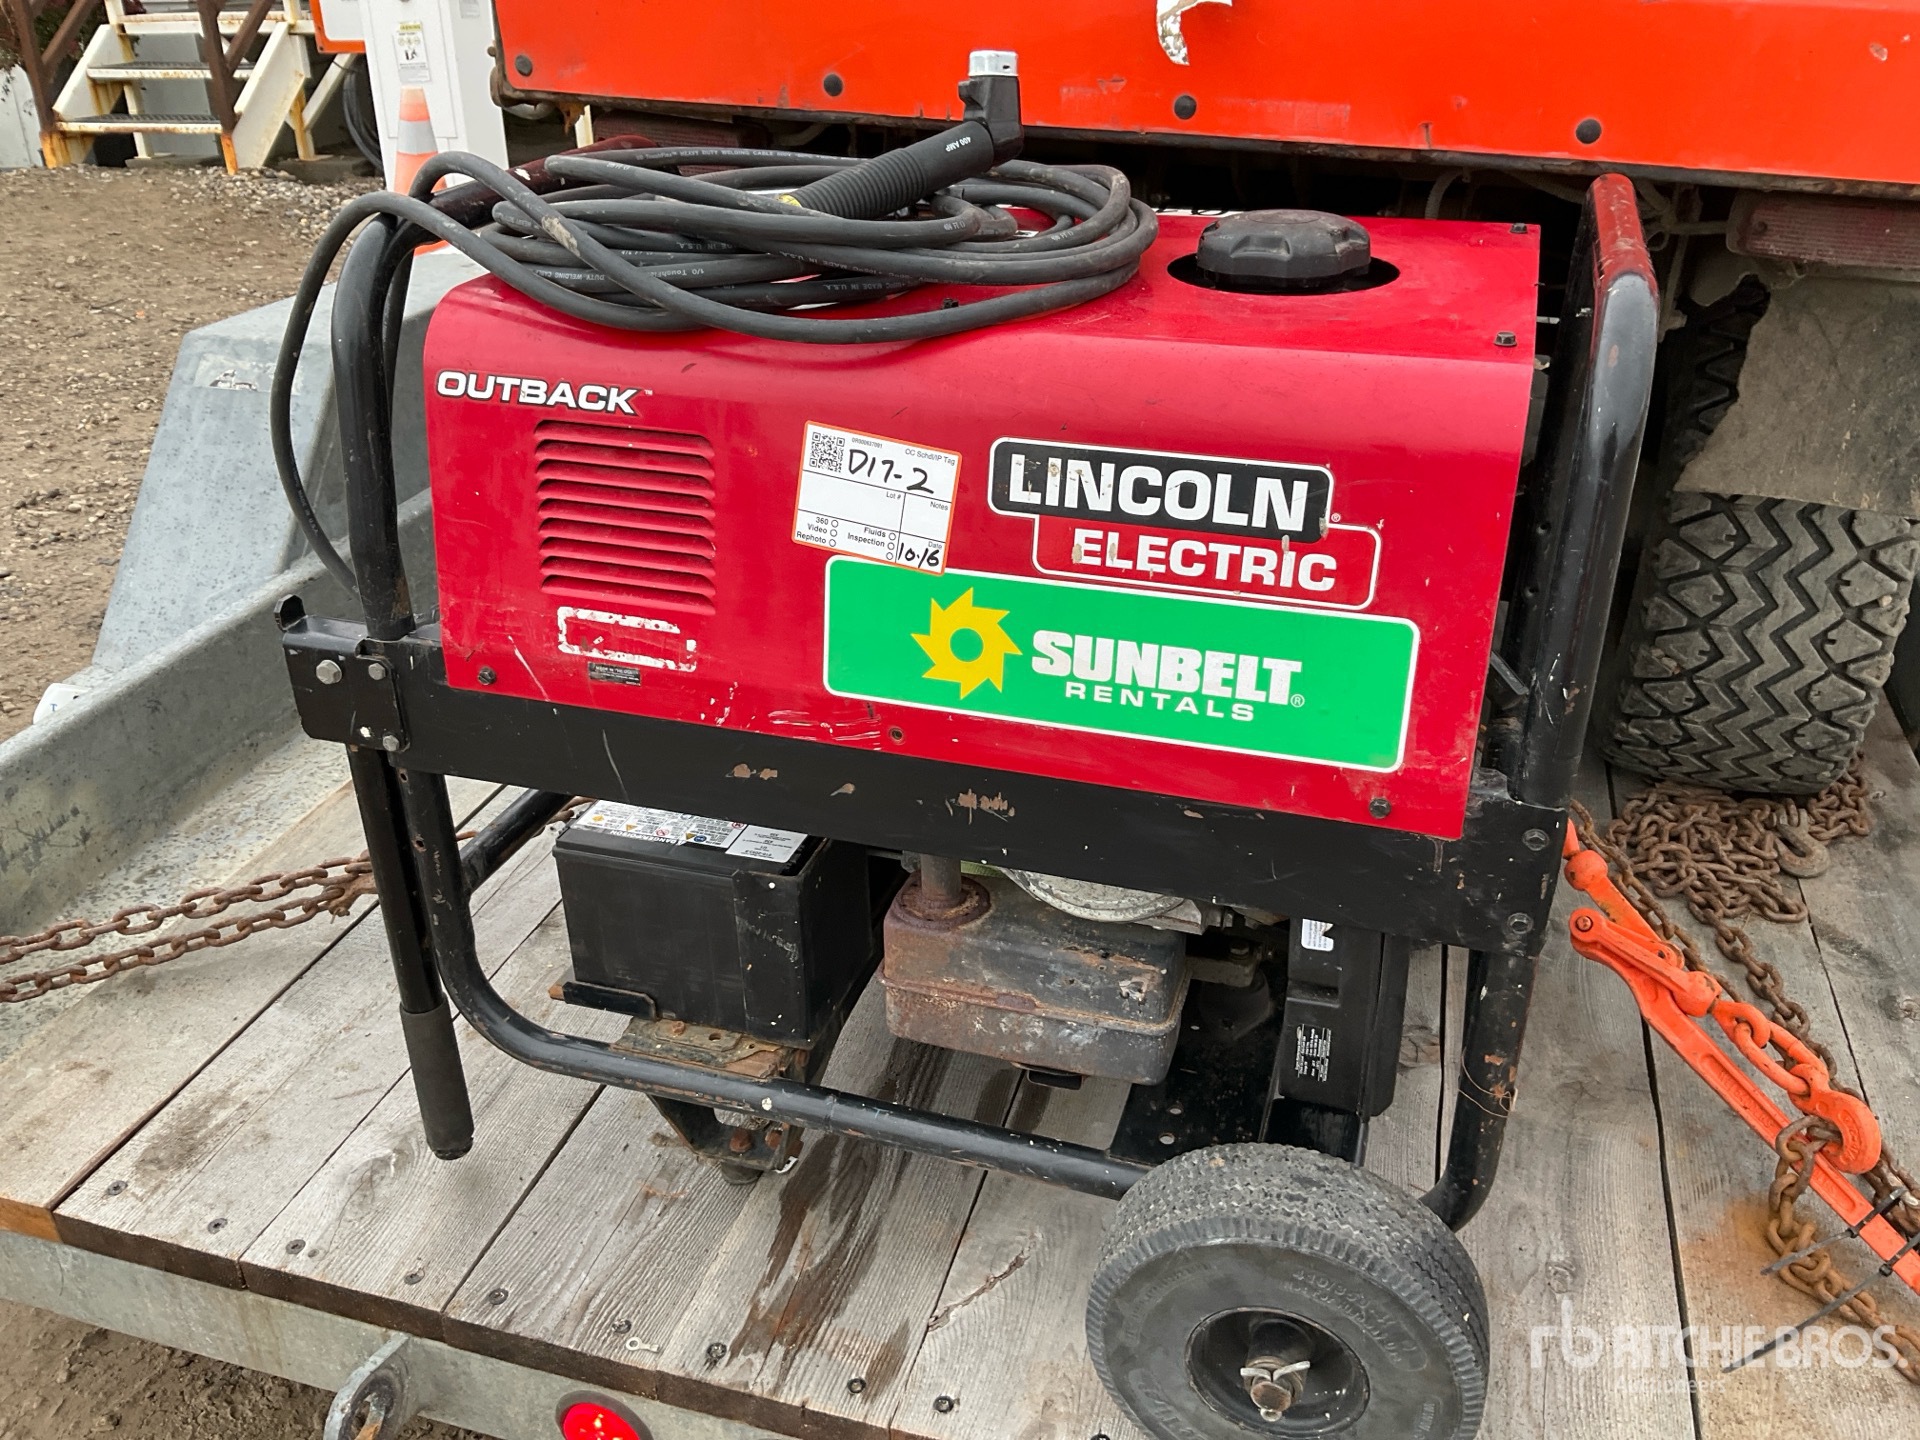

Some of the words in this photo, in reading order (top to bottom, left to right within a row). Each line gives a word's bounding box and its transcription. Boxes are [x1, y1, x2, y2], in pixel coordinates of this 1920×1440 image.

[945, 140, 960, 152] AMP
[960, 136, 971, 146] 400
[554, 272, 583, 280] WELDING
[648, 268, 687, 277] ToughFl
[437, 370, 639, 414] OUTBACK
[944, 456, 956, 466] Tag
[886, 492, 896, 500] Lot
[1008, 454, 1309, 532] LINCOLN
[930, 501, 949, 511] Notes
[815, 516, 829, 526] 360
[807, 524, 828, 534] Video
[864, 527, 886, 538] Fluids
[796, 532, 827, 546] Rephoto
[847, 532, 885, 548] Inspection
[928, 540, 942, 550] Date
[1072, 528, 1337, 592] ELECTRIC
[1031, 629, 1302, 706] SUNBELT
[1065, 681, 1254, 722] RENTALS
